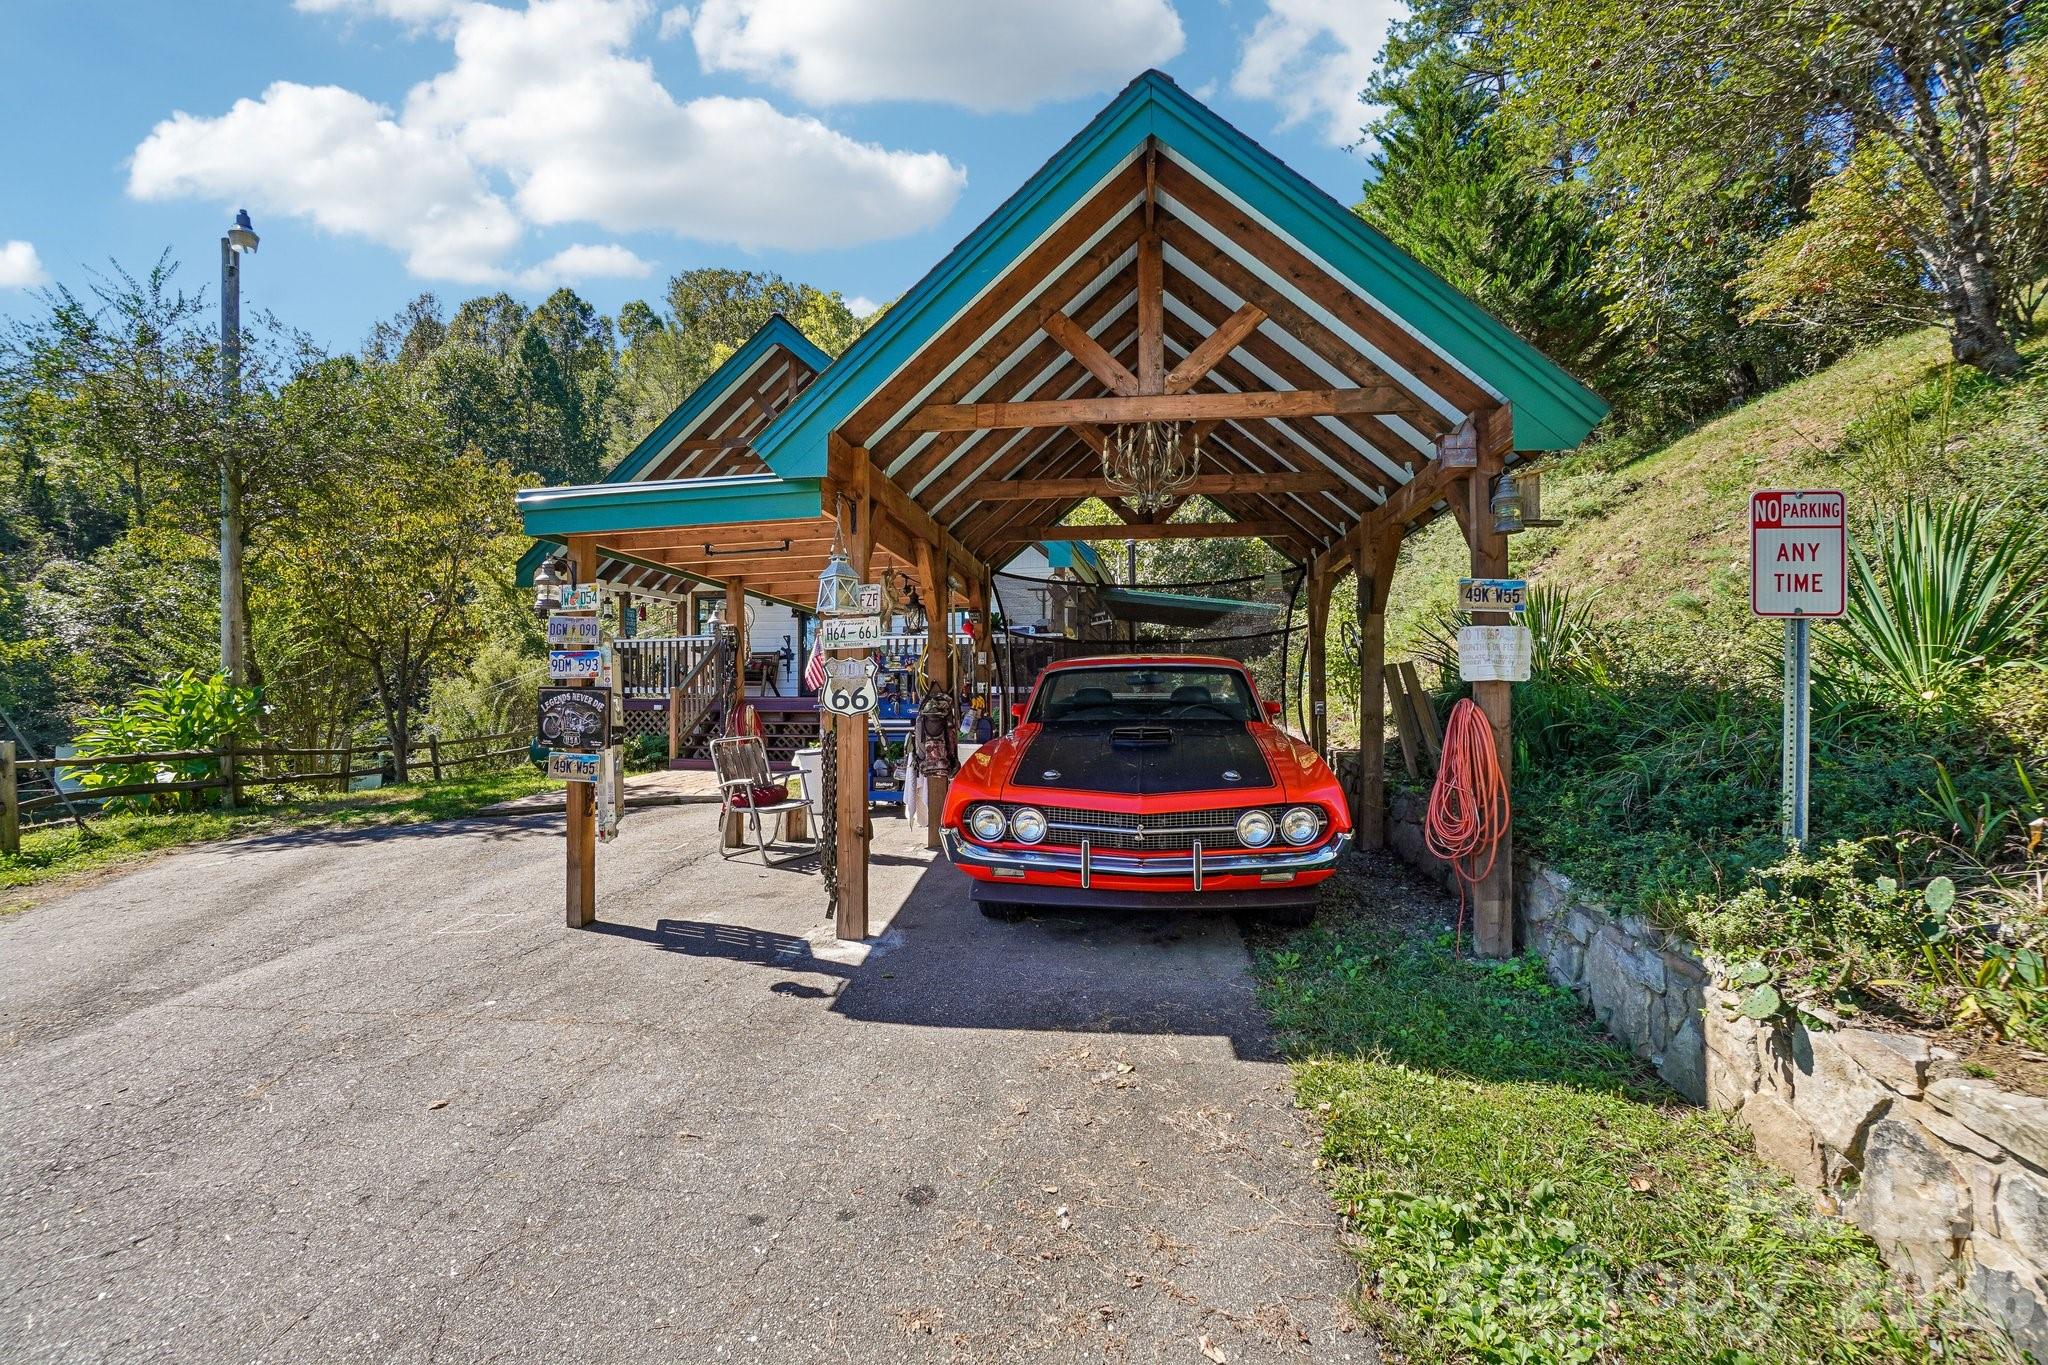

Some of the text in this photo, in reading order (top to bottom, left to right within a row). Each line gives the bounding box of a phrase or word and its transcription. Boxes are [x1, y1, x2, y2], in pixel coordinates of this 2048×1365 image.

[1755, 499, 1840, 522] NO PARKING
[1776, 542, 1821, 562] ANY
[1774, 573, 1823, 593] TIME
[1465, 587, 1520, 603] 49K W55
[578, 658, 599, 672] 593
[540, 692, 606, 713] LEGENDS NEVER DIE
[831, 686, 869, 710] 66
[553, 760, 596, 775] 49K W55
